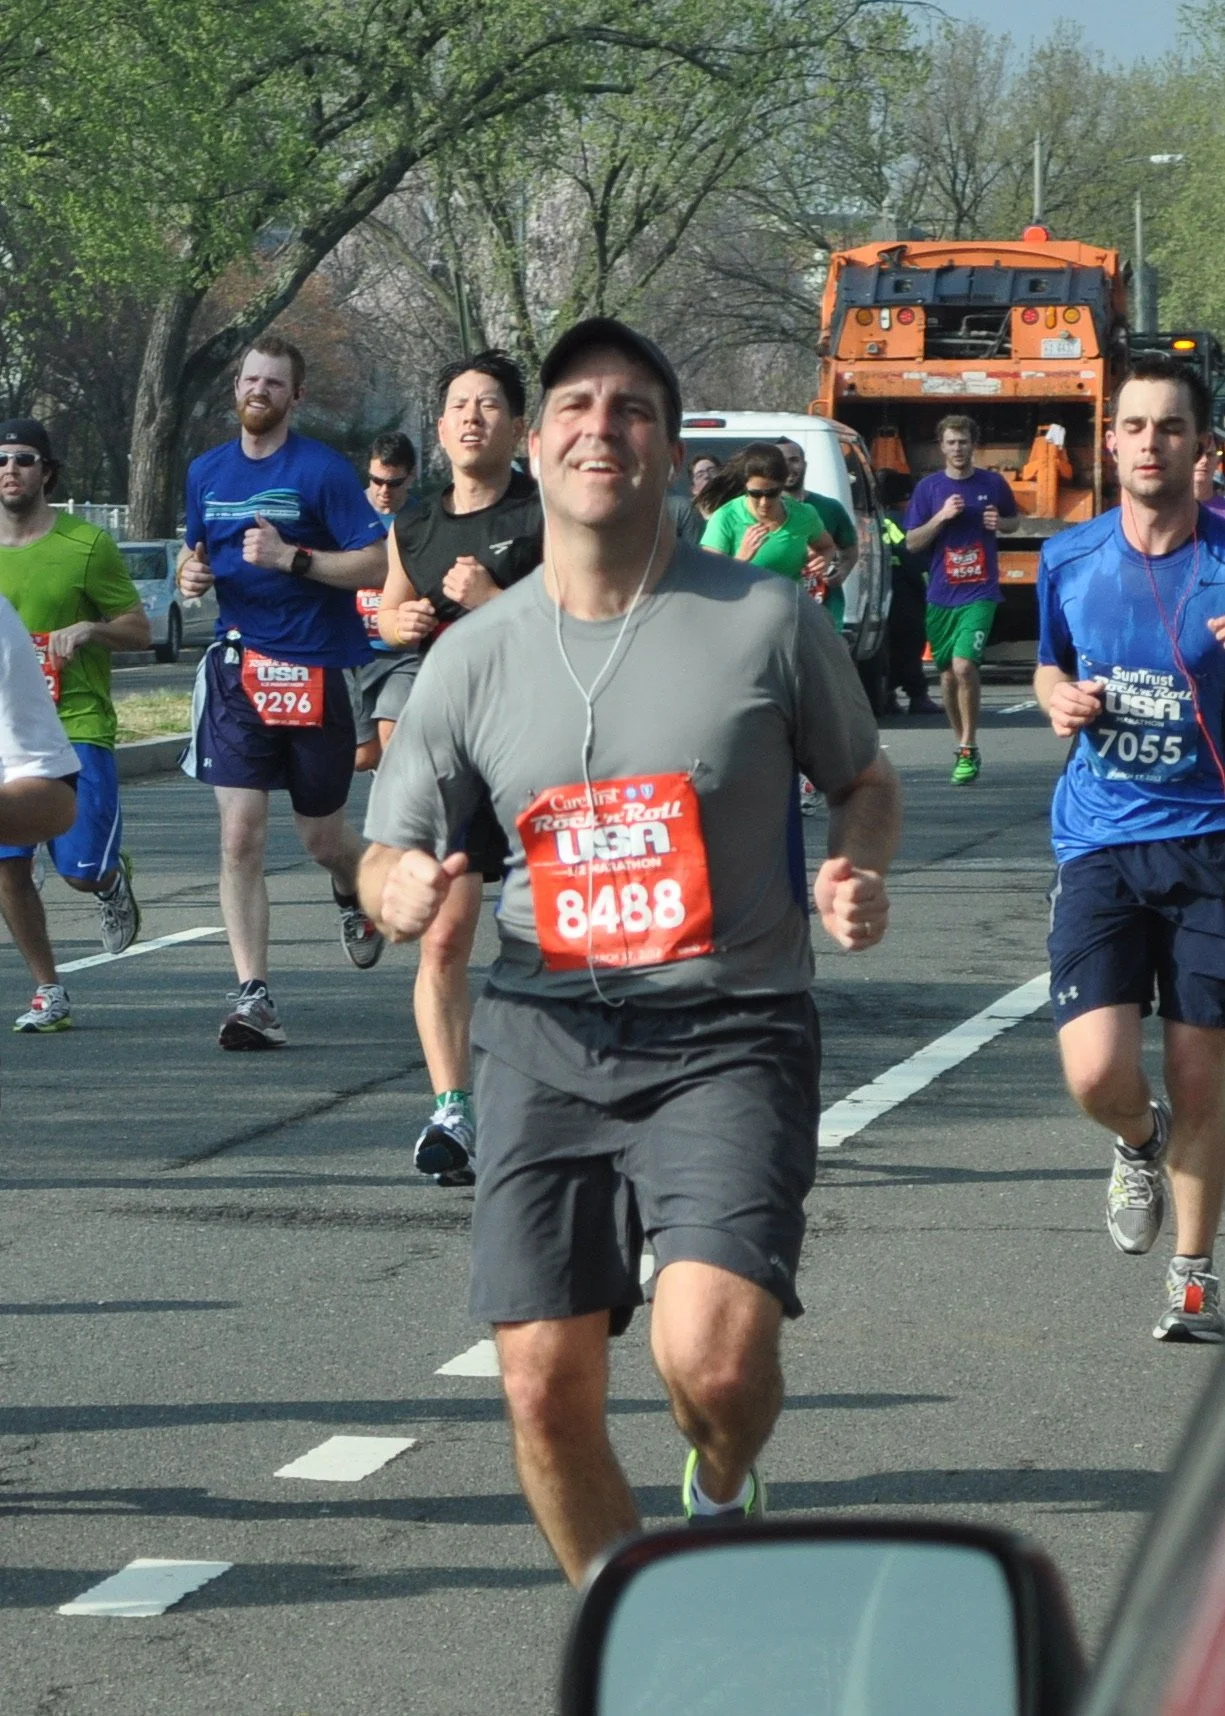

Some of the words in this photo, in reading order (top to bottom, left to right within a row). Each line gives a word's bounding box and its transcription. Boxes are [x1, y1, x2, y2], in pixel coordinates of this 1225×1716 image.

[257, 666, 309, 681] USA
[1112, 666, 1174, 687] SunTrust
[253, 691, 312, 713] 9296
[1105, 692, 1181, 720] USA
[1098, 728, 1183, 764] 7055
[531, 811, 600, 834] Rock
[622, 800, 684, 823] Roll
[556, 821, 671, 865] USA
[556, 878, 686, 939] 8488
